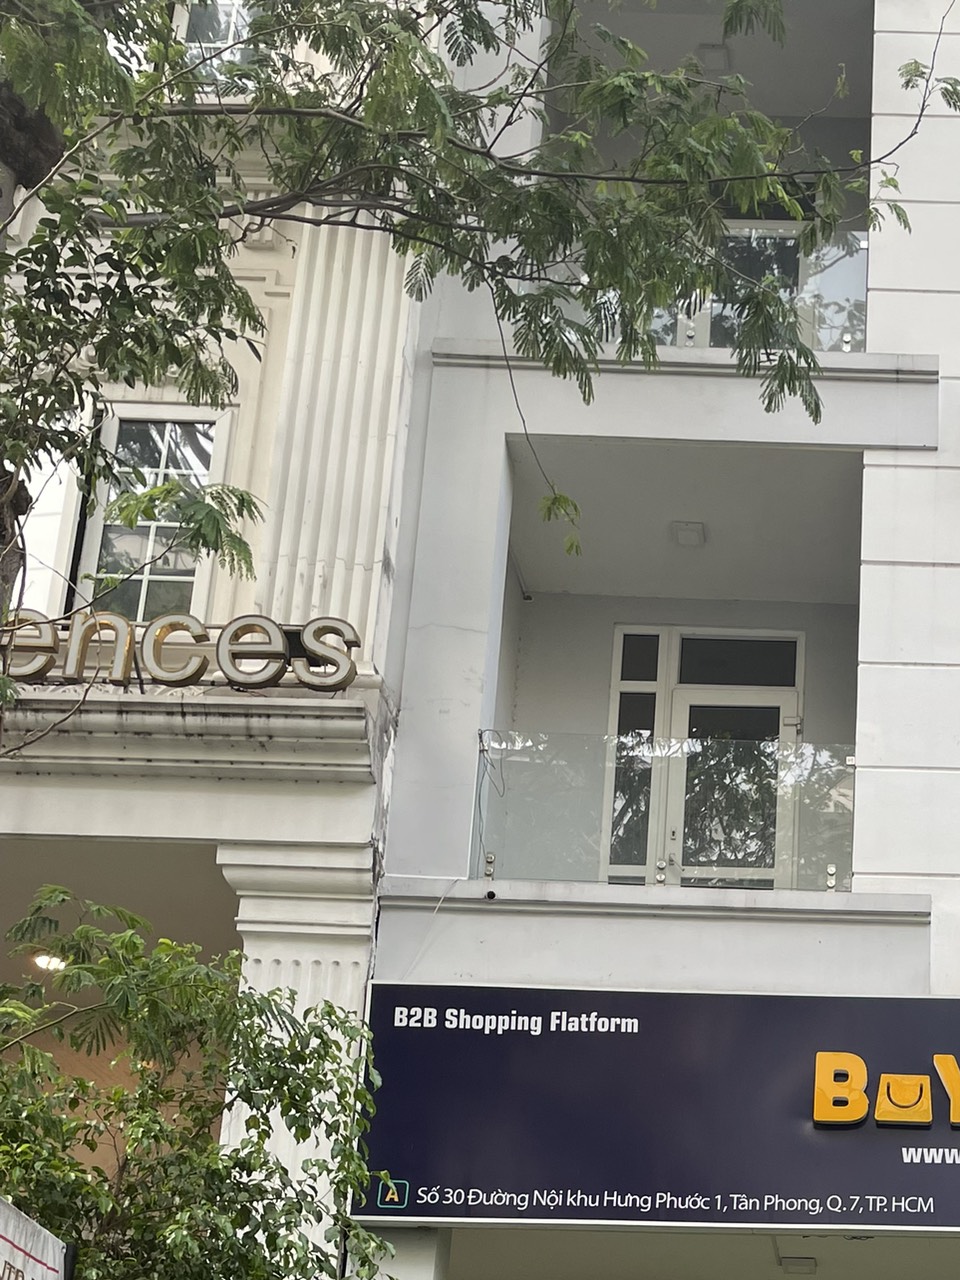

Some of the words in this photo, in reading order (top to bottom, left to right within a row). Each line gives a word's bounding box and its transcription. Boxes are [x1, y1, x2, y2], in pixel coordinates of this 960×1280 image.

[394, 1007, 438, 1028] B2B
[445, 1008, 542, 1036] Shopping
[550, 1012, 639, 1033] Flatform
[385, 1189, 398, 1202] A
[416, 1186, 440, 1204] Số
[443, 1189, 465, 1205] 30
[467, 1189, 529, 1210] Đường
[532, 1190, 563, 1210] Nội
[567, 1190, 600, 1208] khu
[603, 1191, 652, 1212] Hưng
[656, 1192, 710, 1210] Phước
[715, 1194, 728, 1213] 1,
[730, 1194, 759, 1210] Tân
[764, 1195, 824, 1215] Phong,
[892, 1197, 934, 1213] HCM
